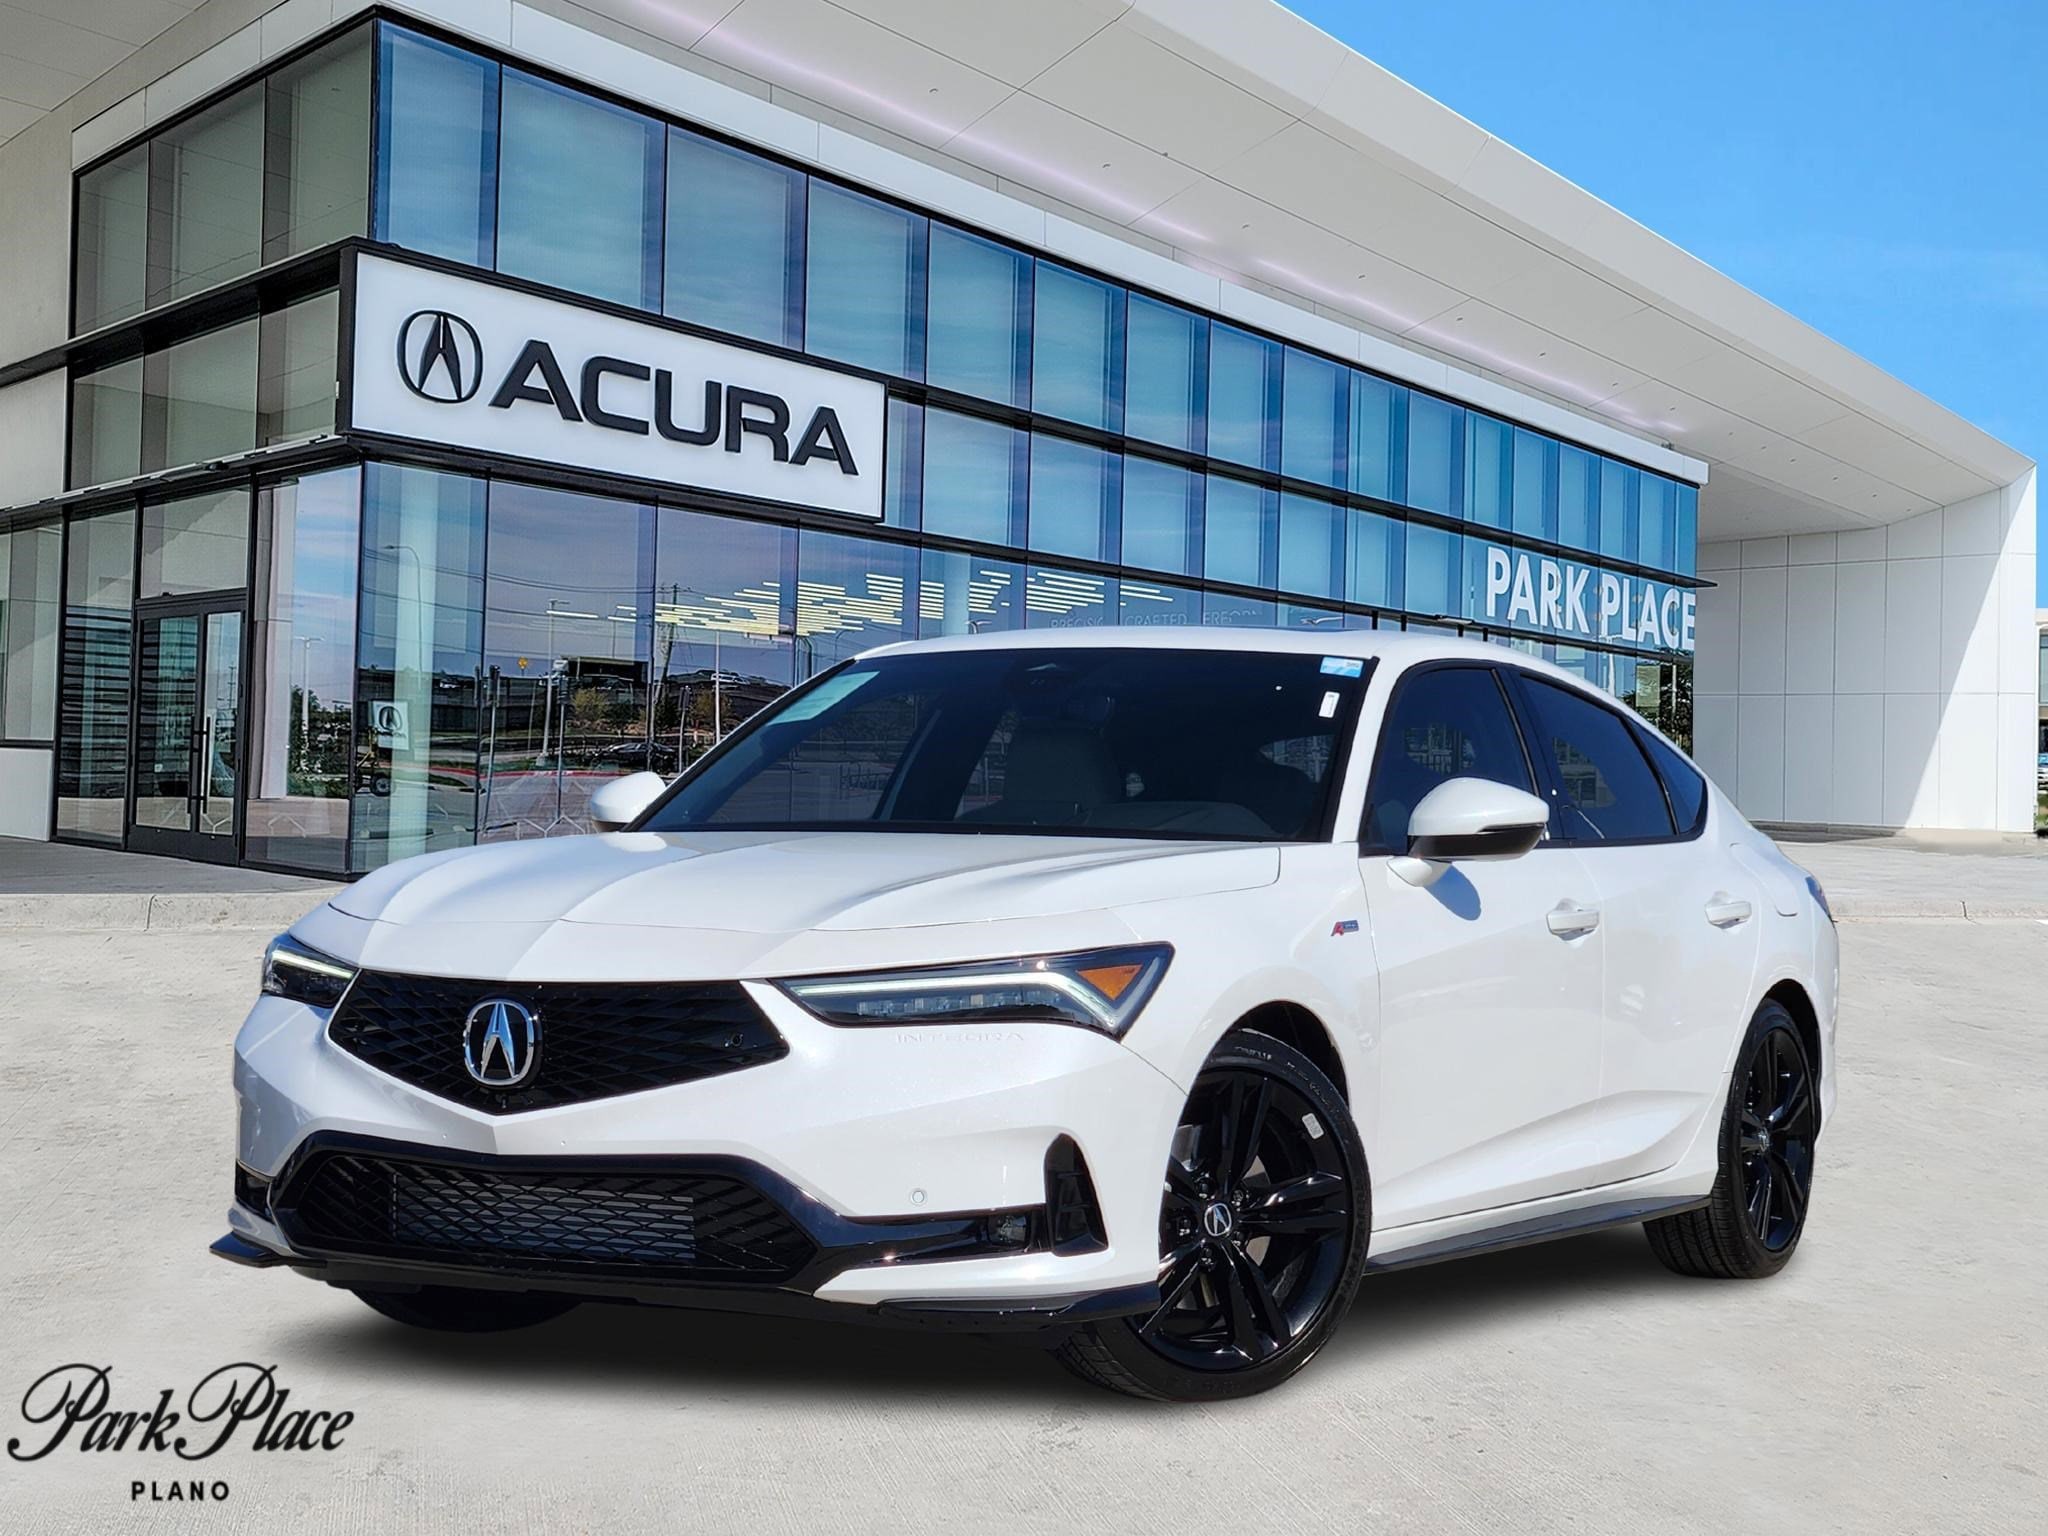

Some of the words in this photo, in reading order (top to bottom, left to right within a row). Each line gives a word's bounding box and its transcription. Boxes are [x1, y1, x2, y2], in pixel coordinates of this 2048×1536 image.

[488, 339, 859, 476] ACURA
[1486, 546, 1590, 634] PARK
[1600, 573, 1697, 650] PLACE
